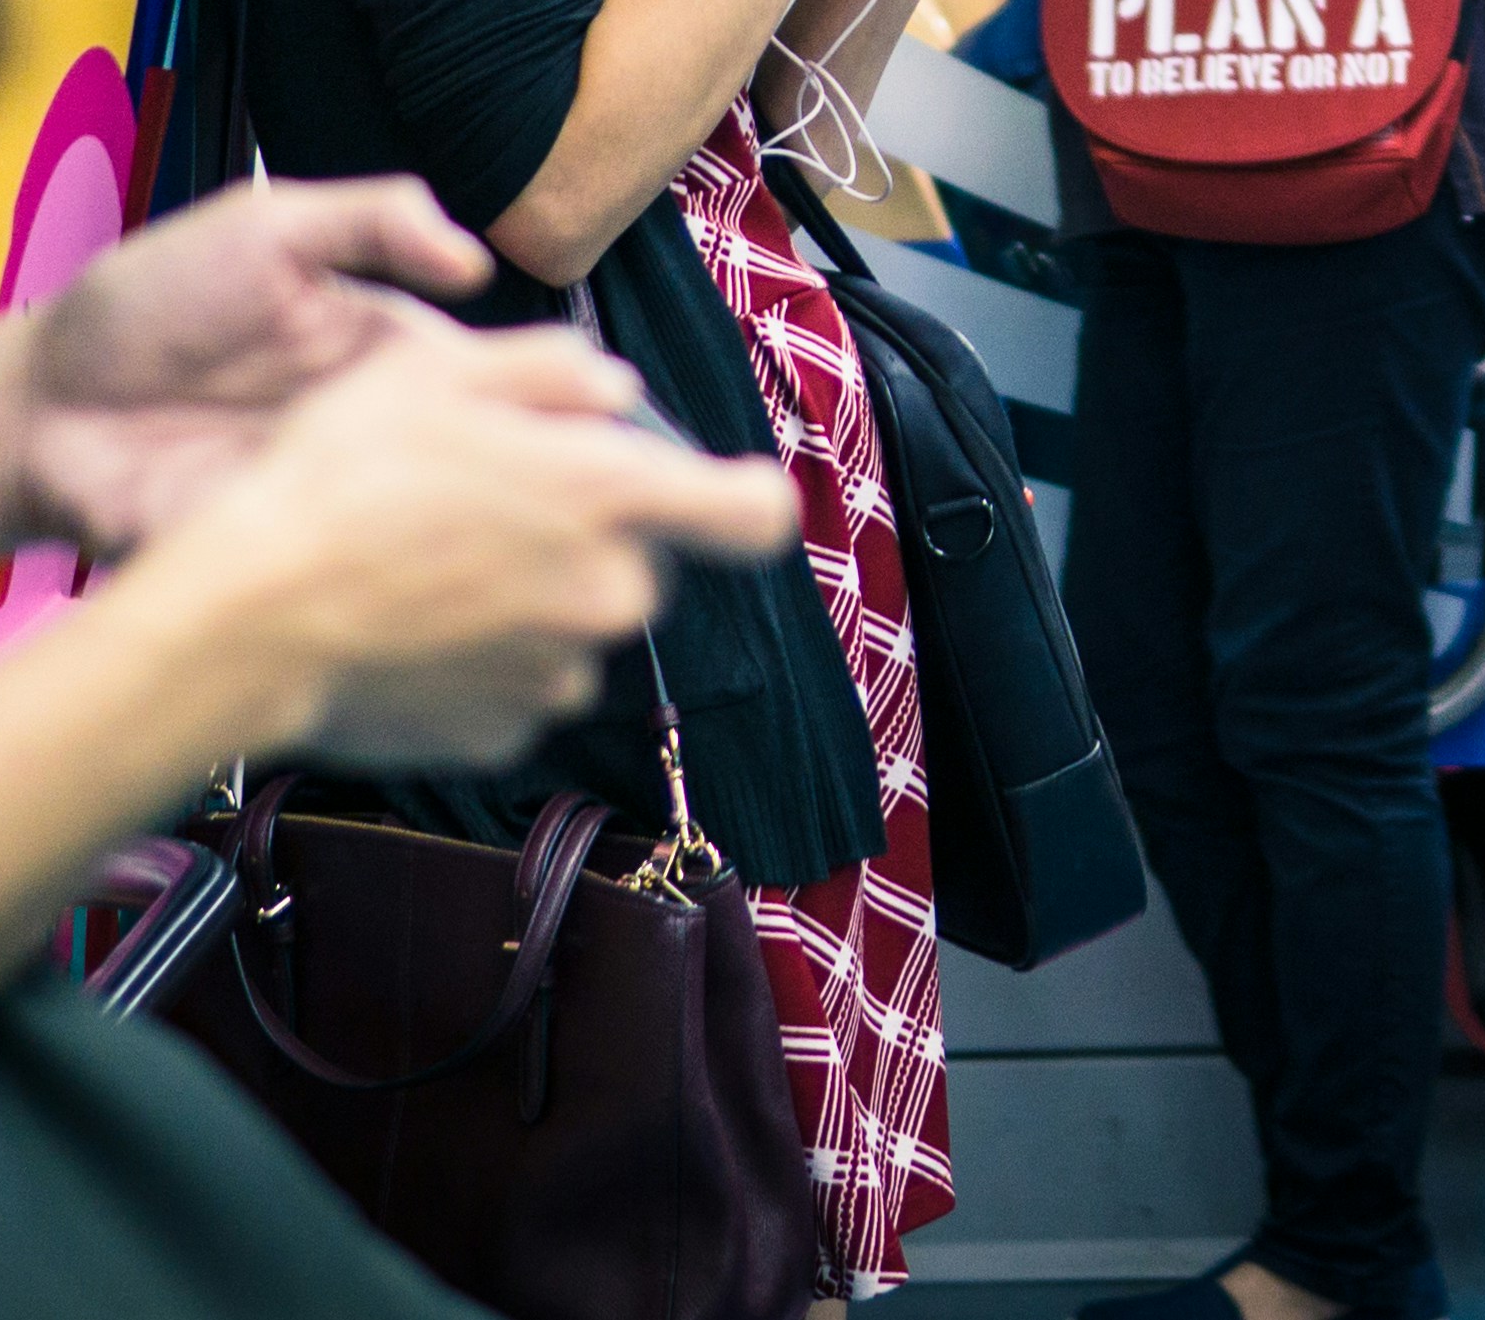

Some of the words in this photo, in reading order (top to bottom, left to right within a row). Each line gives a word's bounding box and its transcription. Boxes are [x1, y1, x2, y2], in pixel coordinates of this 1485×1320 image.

[1089, 61, 1135, 97] TO
[1138, 54, 1284, 94] BELIEVE
[1289, 52, 1341, 89] OR
[1343, 50, 1412, 86] NOT
